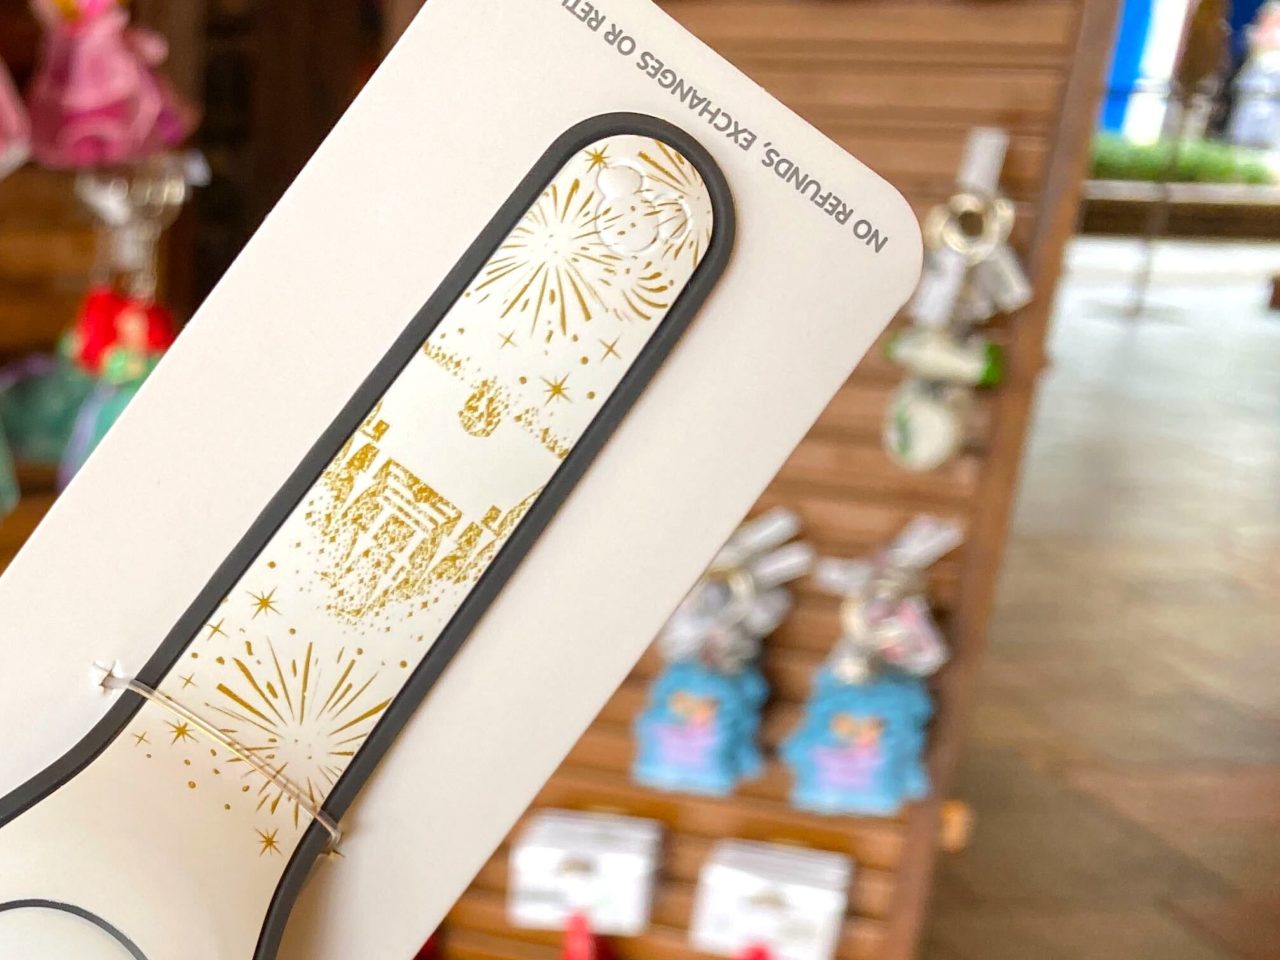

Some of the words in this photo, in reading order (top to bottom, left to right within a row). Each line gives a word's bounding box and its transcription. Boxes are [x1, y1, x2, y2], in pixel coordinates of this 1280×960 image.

[604, 23, 637, 56] OR
[636, 51, 757, 151] EXCHANGES
[761, 141, 855, 226] REFUNDS,
[855, 219, 889, 253] NO
